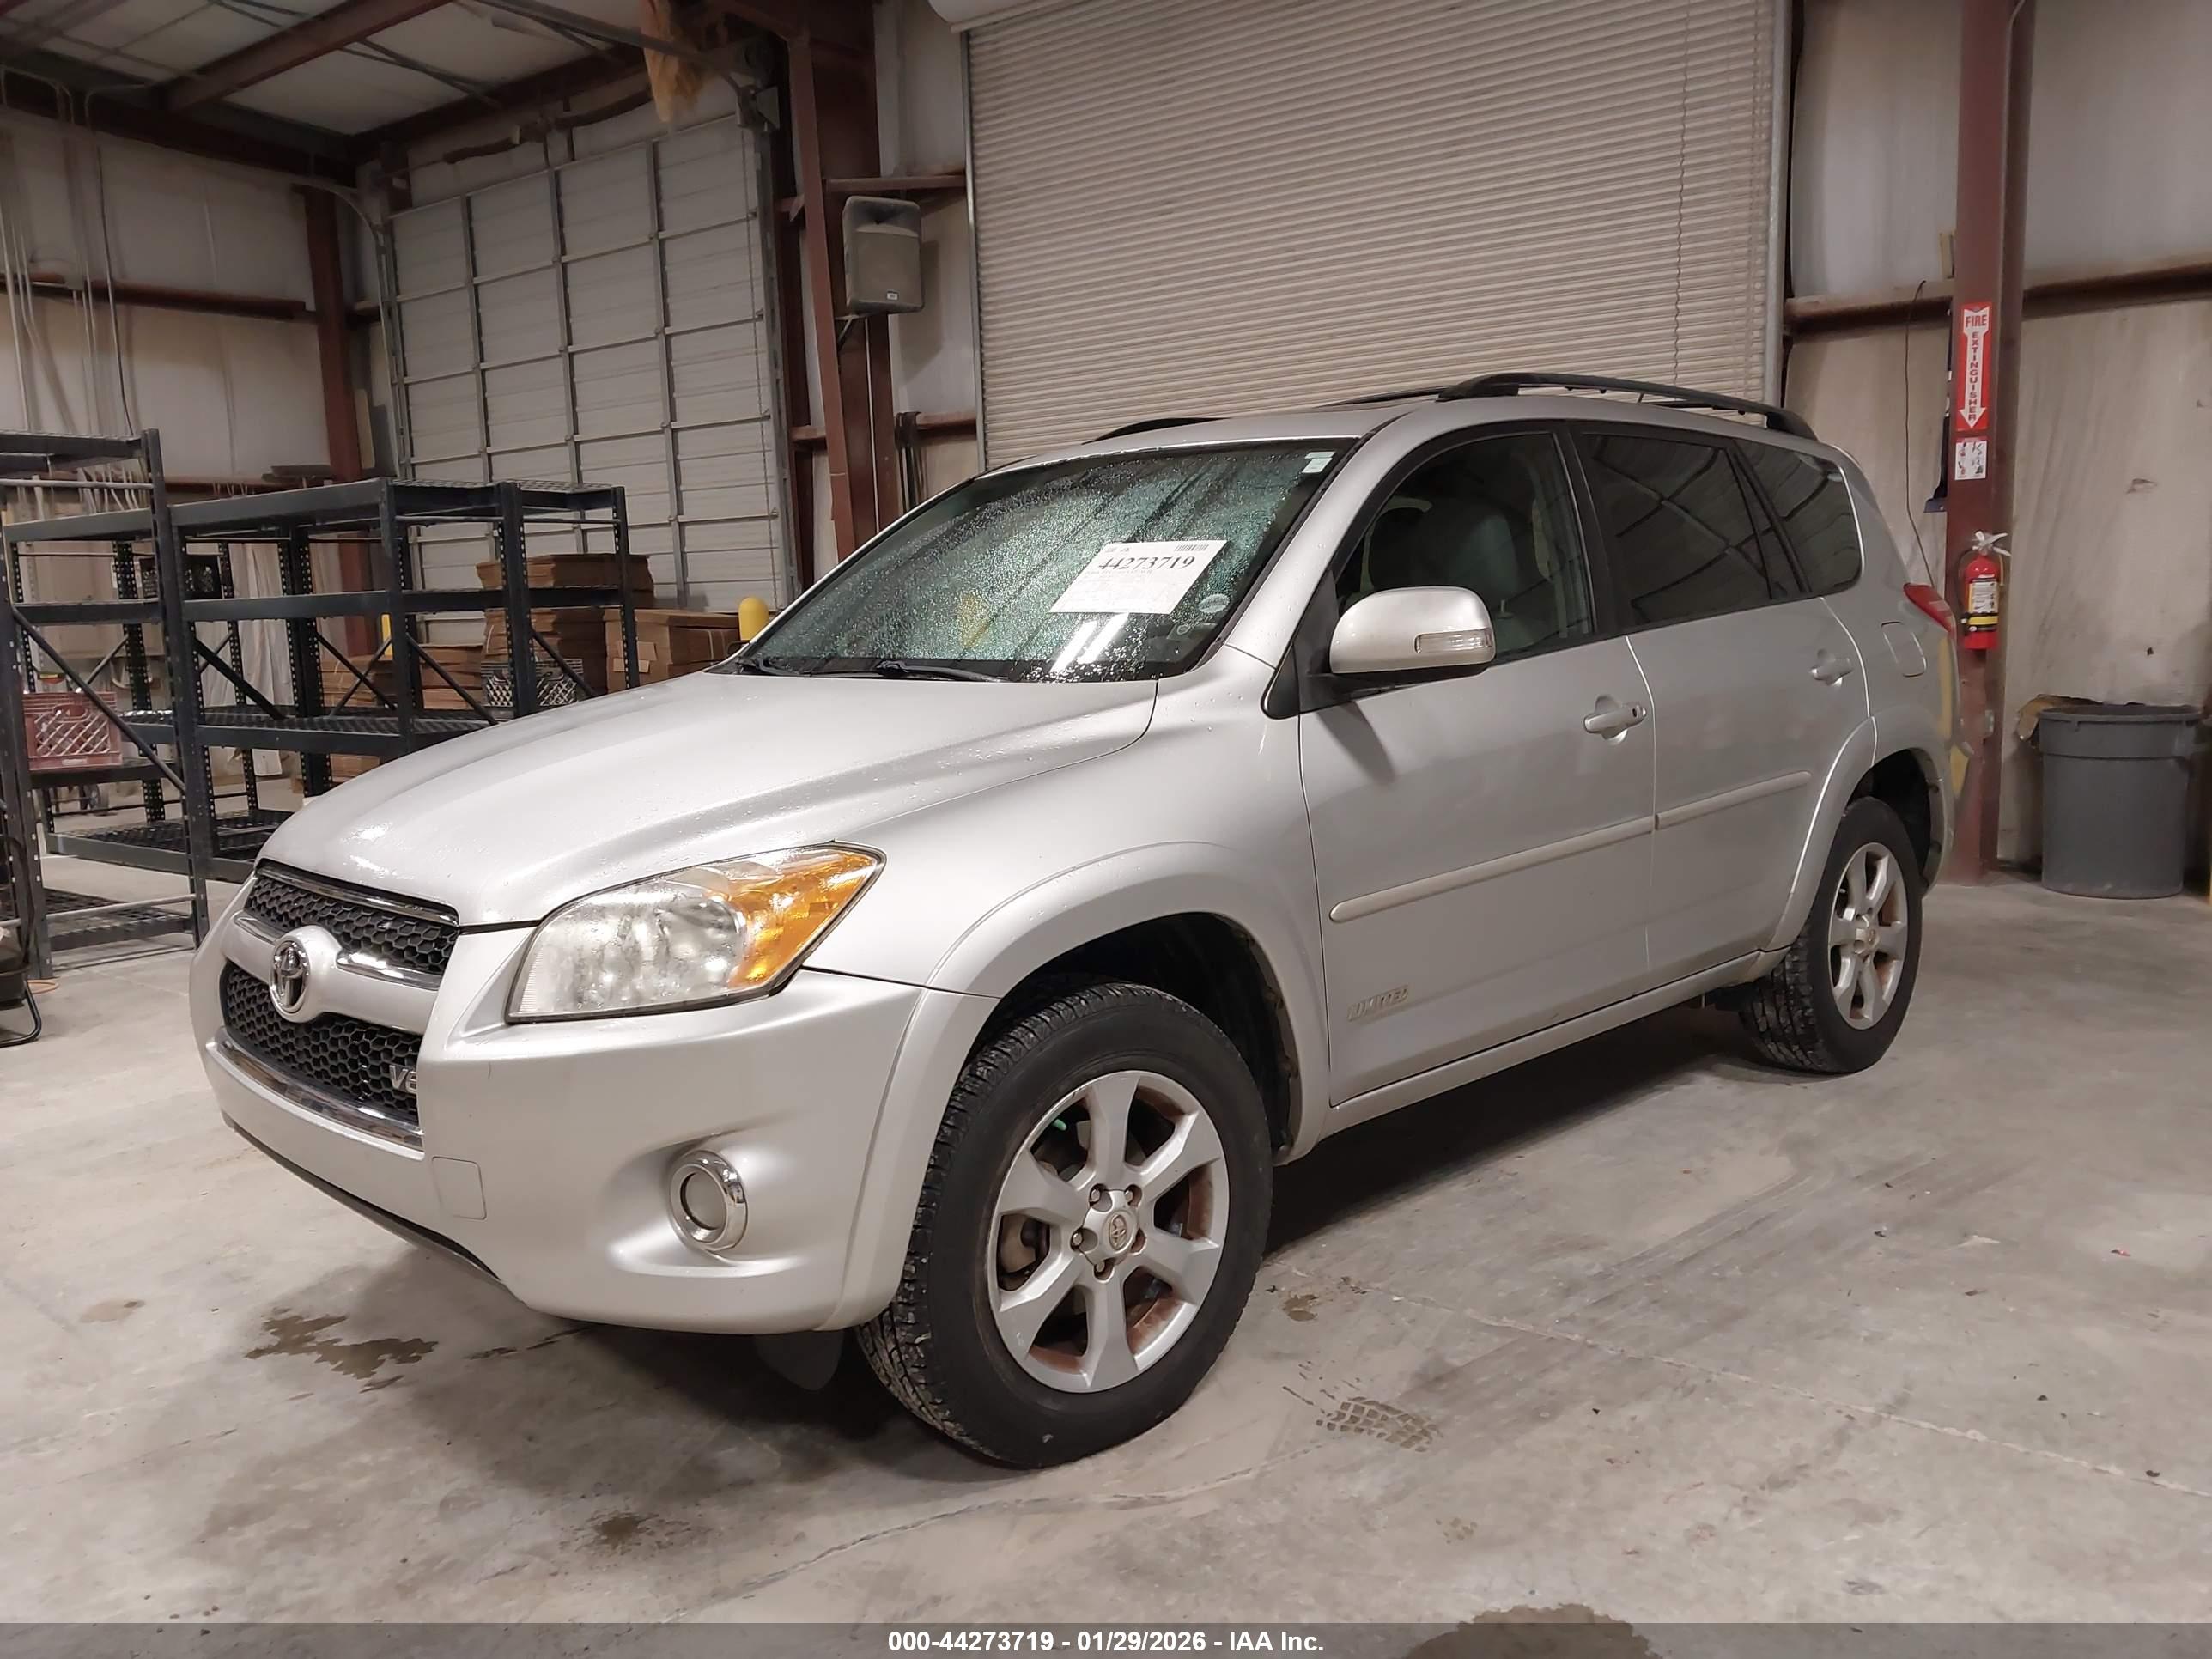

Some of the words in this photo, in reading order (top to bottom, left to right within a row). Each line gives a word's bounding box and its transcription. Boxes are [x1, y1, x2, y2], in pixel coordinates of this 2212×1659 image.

[1965, 314, 1988, 328] FIRE
[1968, 331, 1979, 421] EXTINGUISHER
[1099, 556, 1195, 570] 44273719
